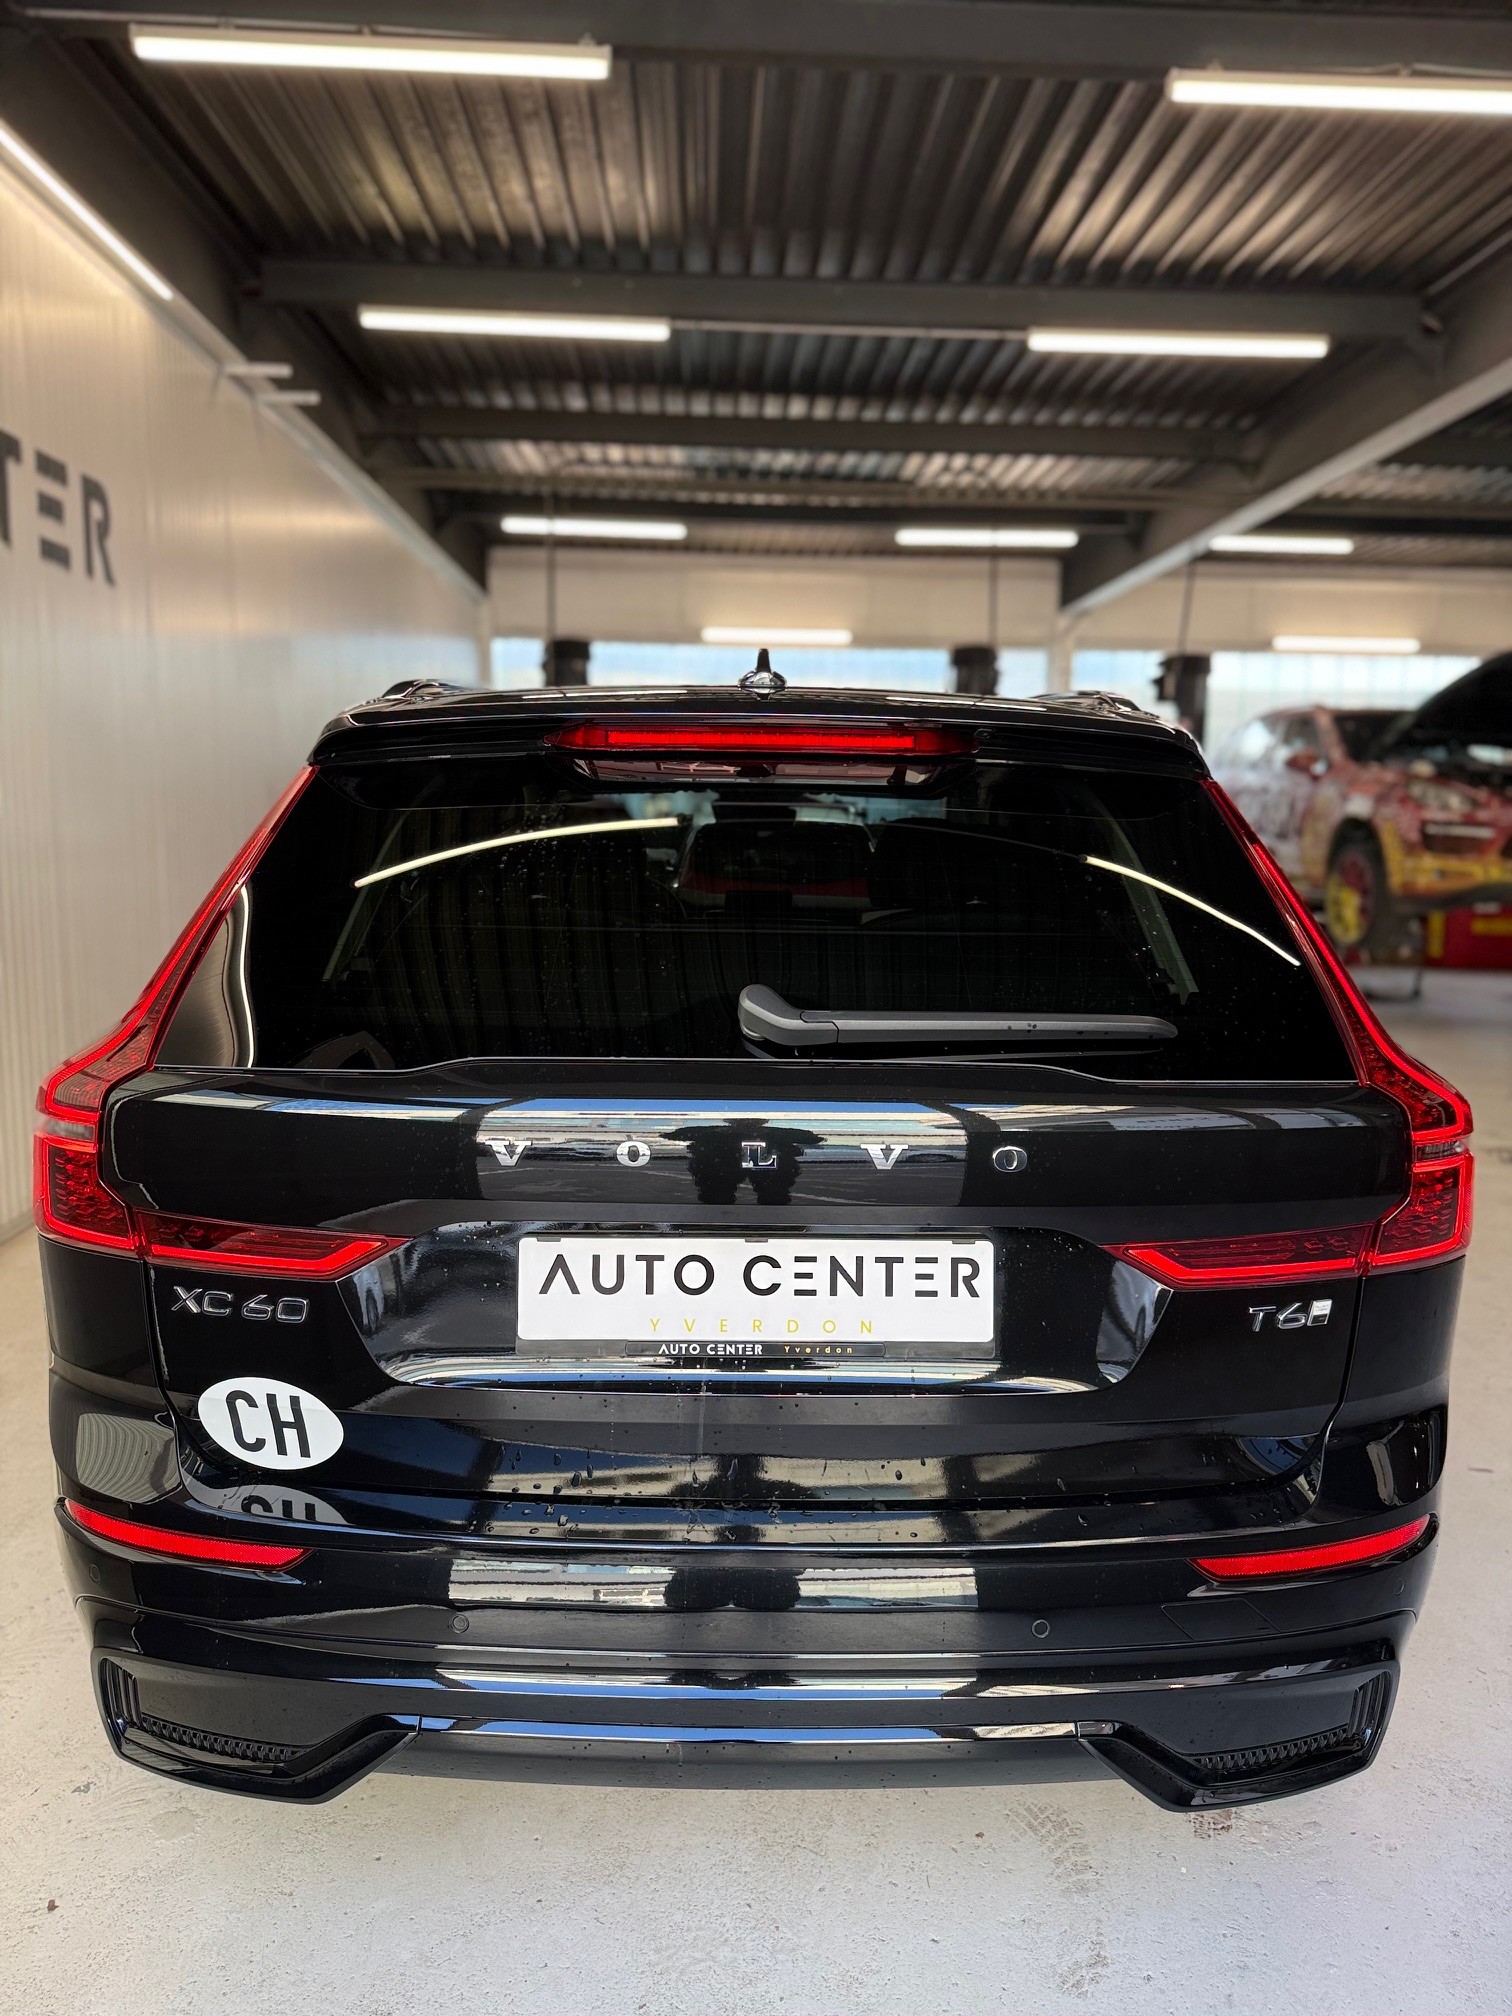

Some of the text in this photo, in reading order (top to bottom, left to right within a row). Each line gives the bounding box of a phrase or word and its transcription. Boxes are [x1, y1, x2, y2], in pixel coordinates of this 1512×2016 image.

[485, 1140, 1028, 1173] VOLVO
[538, 1253, 981, 1298] AUTO CENTER
[650, 1319, 874, 1334] YVERDON
[1248, 1302, 1308, 1332] T6
[658, 1343, 853, 1356] AUTO CENTER Yverdon
[225, 1389, 311, 1459] CH
